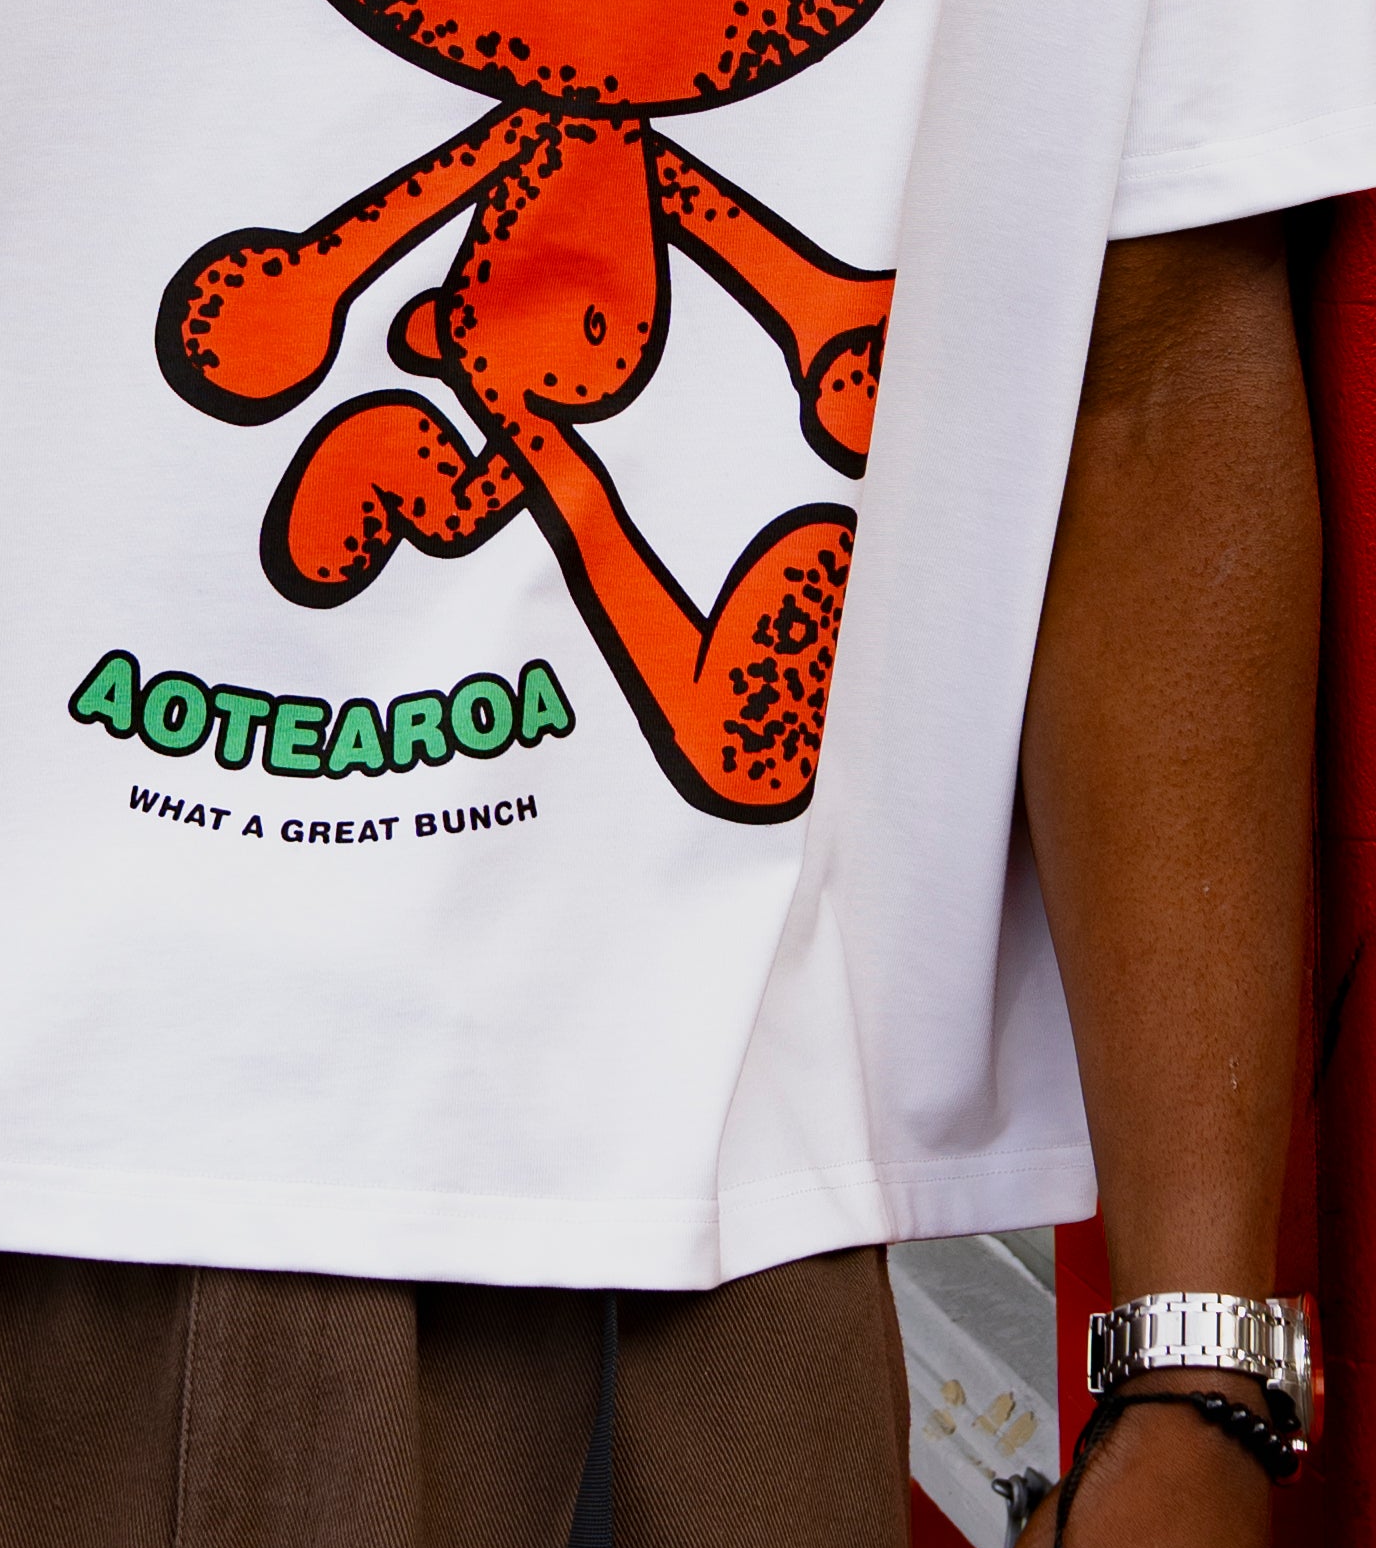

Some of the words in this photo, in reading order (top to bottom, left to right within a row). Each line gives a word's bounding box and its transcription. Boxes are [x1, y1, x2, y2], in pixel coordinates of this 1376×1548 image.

[68, 649, 576, 779] AOTEAROA
[128, 785, 231, 831] WHAT
[242, 814, 264, 839] A
[280, 817, 400, 844] GREAT
[414, 794, 539, 838] BUNCH
